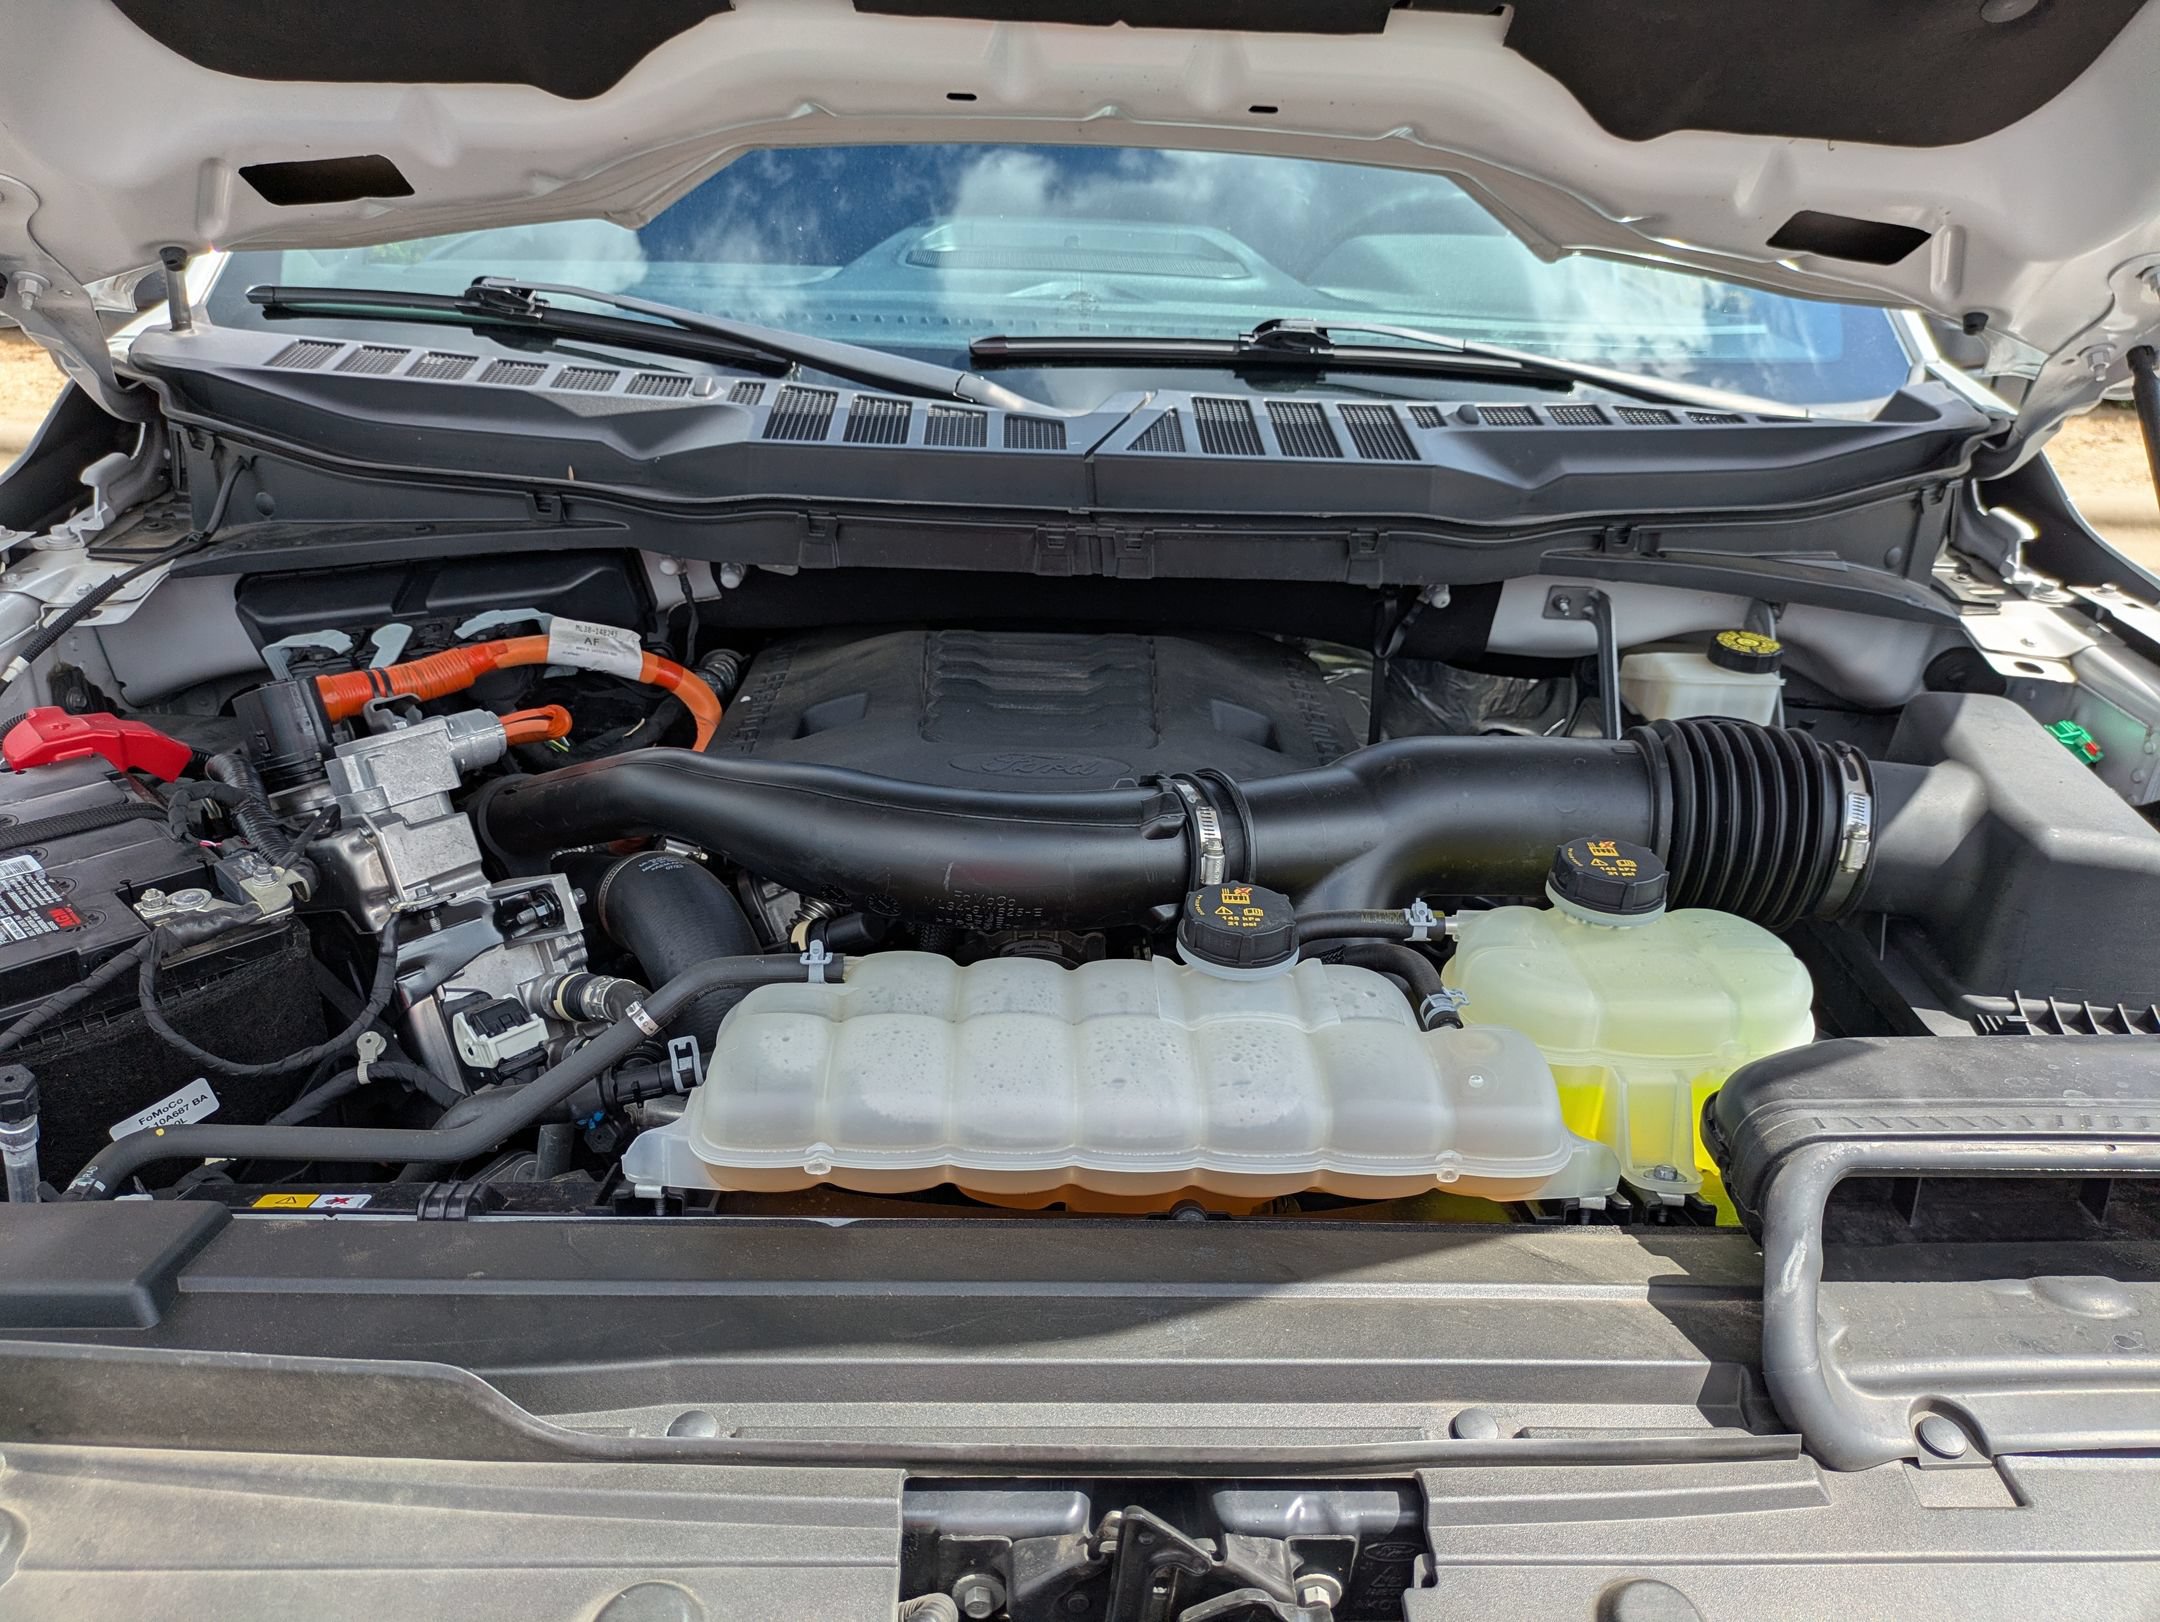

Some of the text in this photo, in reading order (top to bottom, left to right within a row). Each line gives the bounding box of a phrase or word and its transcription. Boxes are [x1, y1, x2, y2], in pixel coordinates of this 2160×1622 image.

[584, 637, 600, 646] AF
[980, 753, 1103, 777] Ford
[138, 1097, 184, 1126] FoMoCo
[154, 1094, 209, 1128] 10A687 BA
